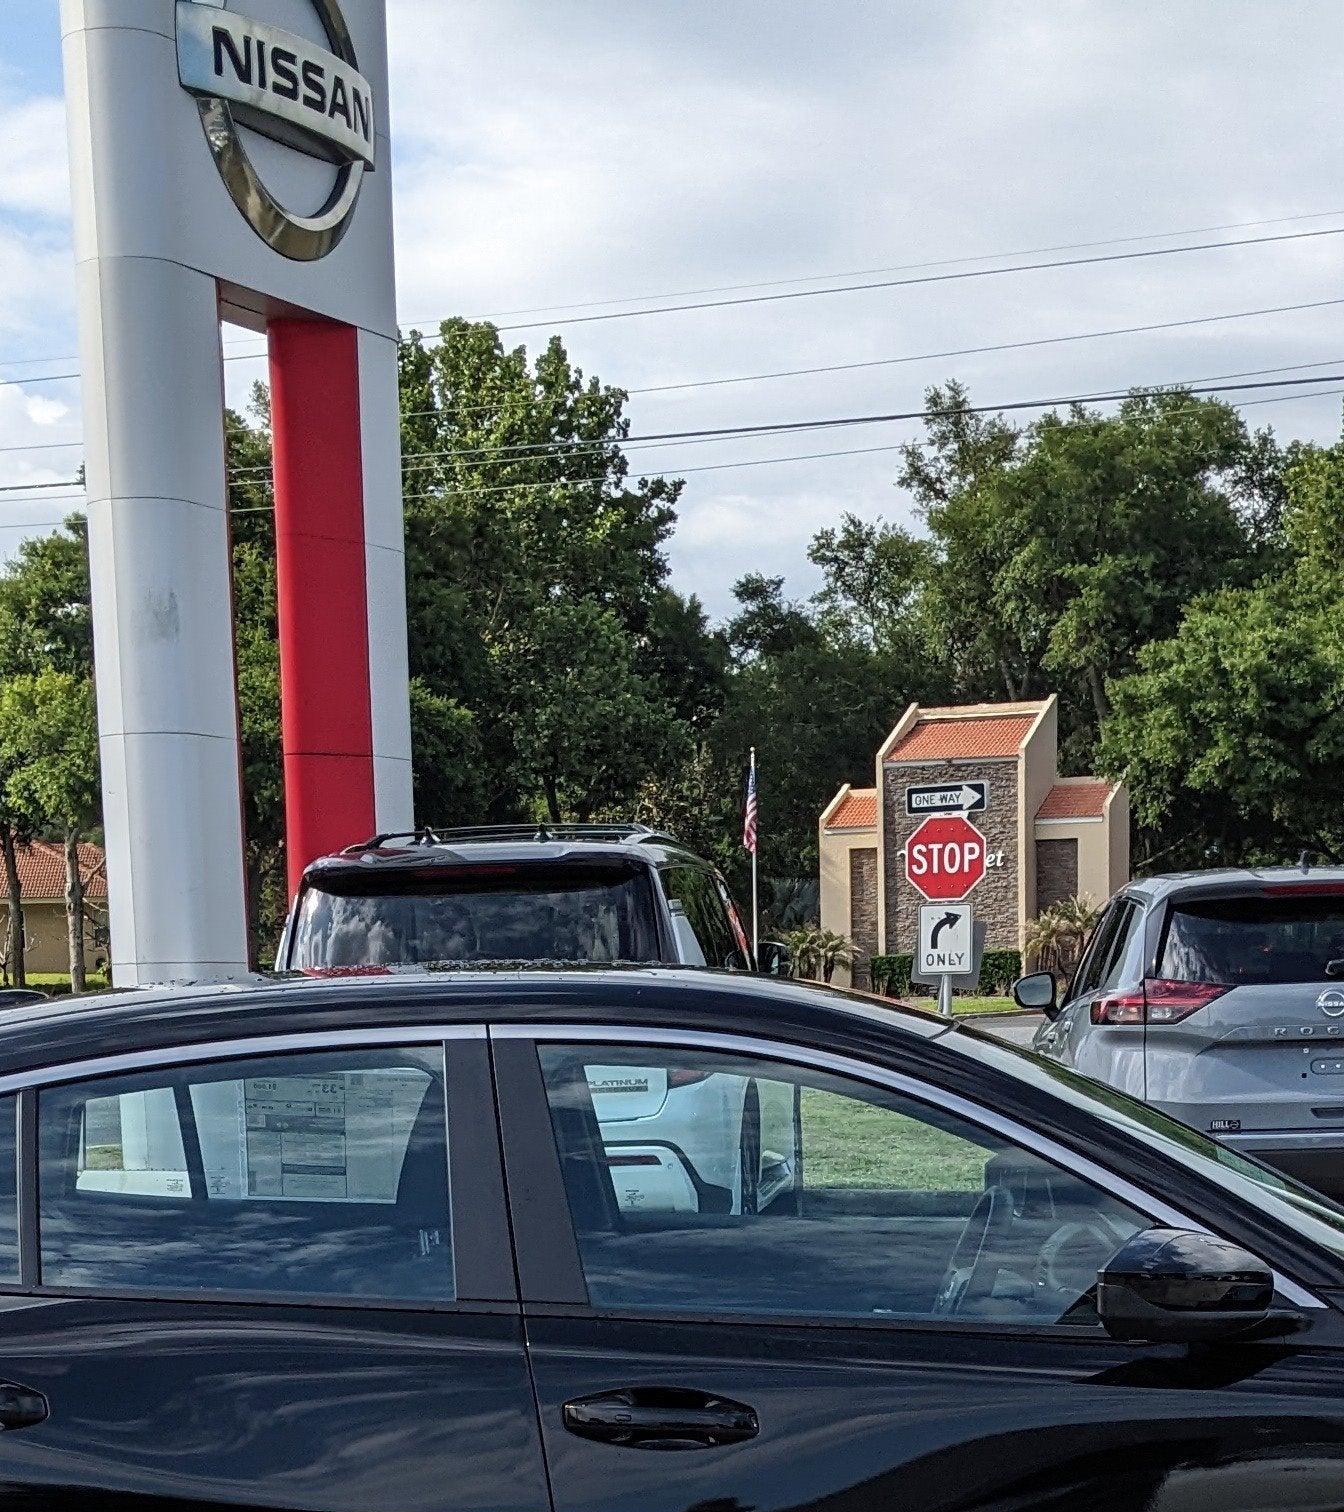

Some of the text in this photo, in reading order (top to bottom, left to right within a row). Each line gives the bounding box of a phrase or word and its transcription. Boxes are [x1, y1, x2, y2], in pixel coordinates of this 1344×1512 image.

[212, 25, 369, 143] NISSAN
[914, 792, 962, 806] ONE WAY
[911, 842, 981, 875] STOP
[925, 953, 965, 967] ONLY
[1212, 1120, 1230, 1129] HILL
